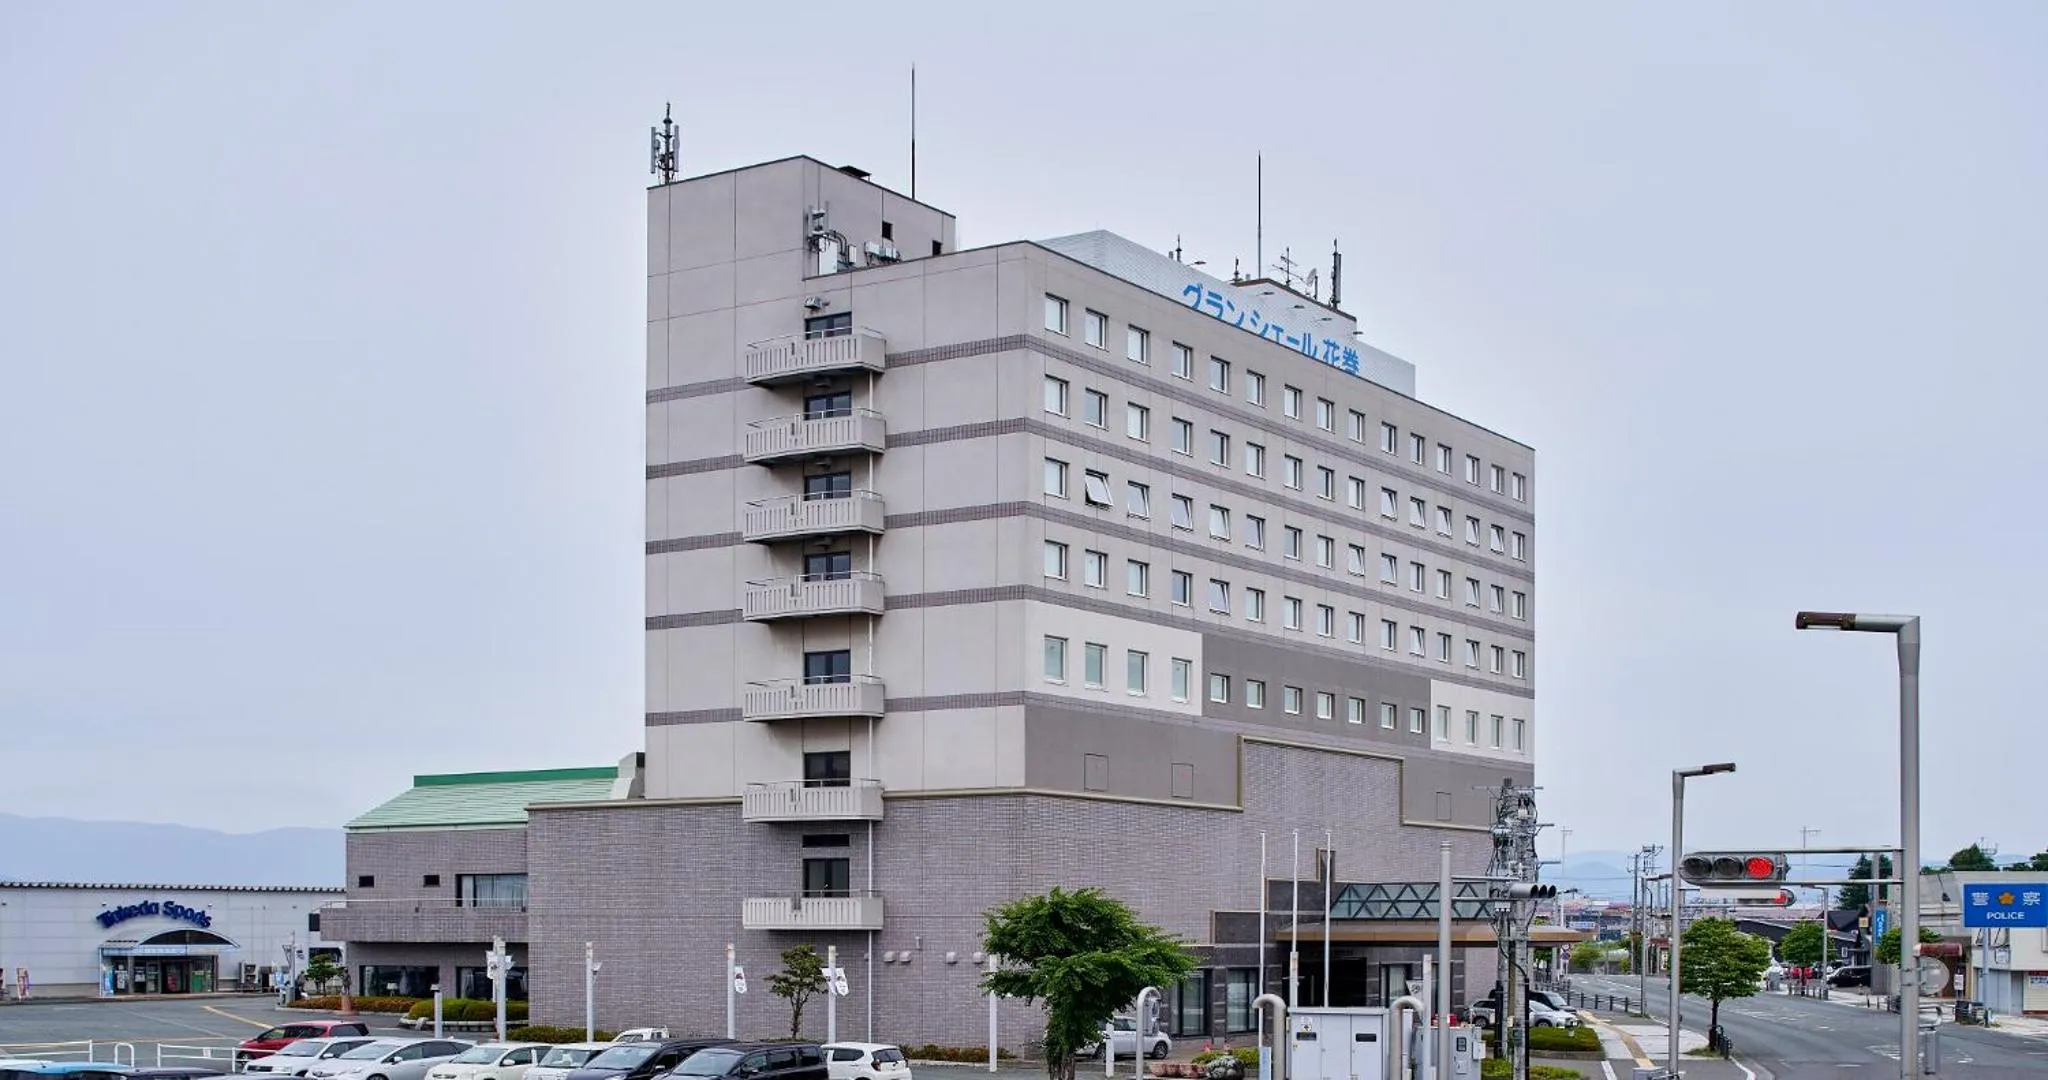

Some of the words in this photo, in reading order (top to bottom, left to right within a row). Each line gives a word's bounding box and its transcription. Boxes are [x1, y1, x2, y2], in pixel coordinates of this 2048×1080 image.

[96, 900, 159, 928] Takeda
[163, 900, 212, 928] Sports
[1986, 911, 2025, 920] POLICE
